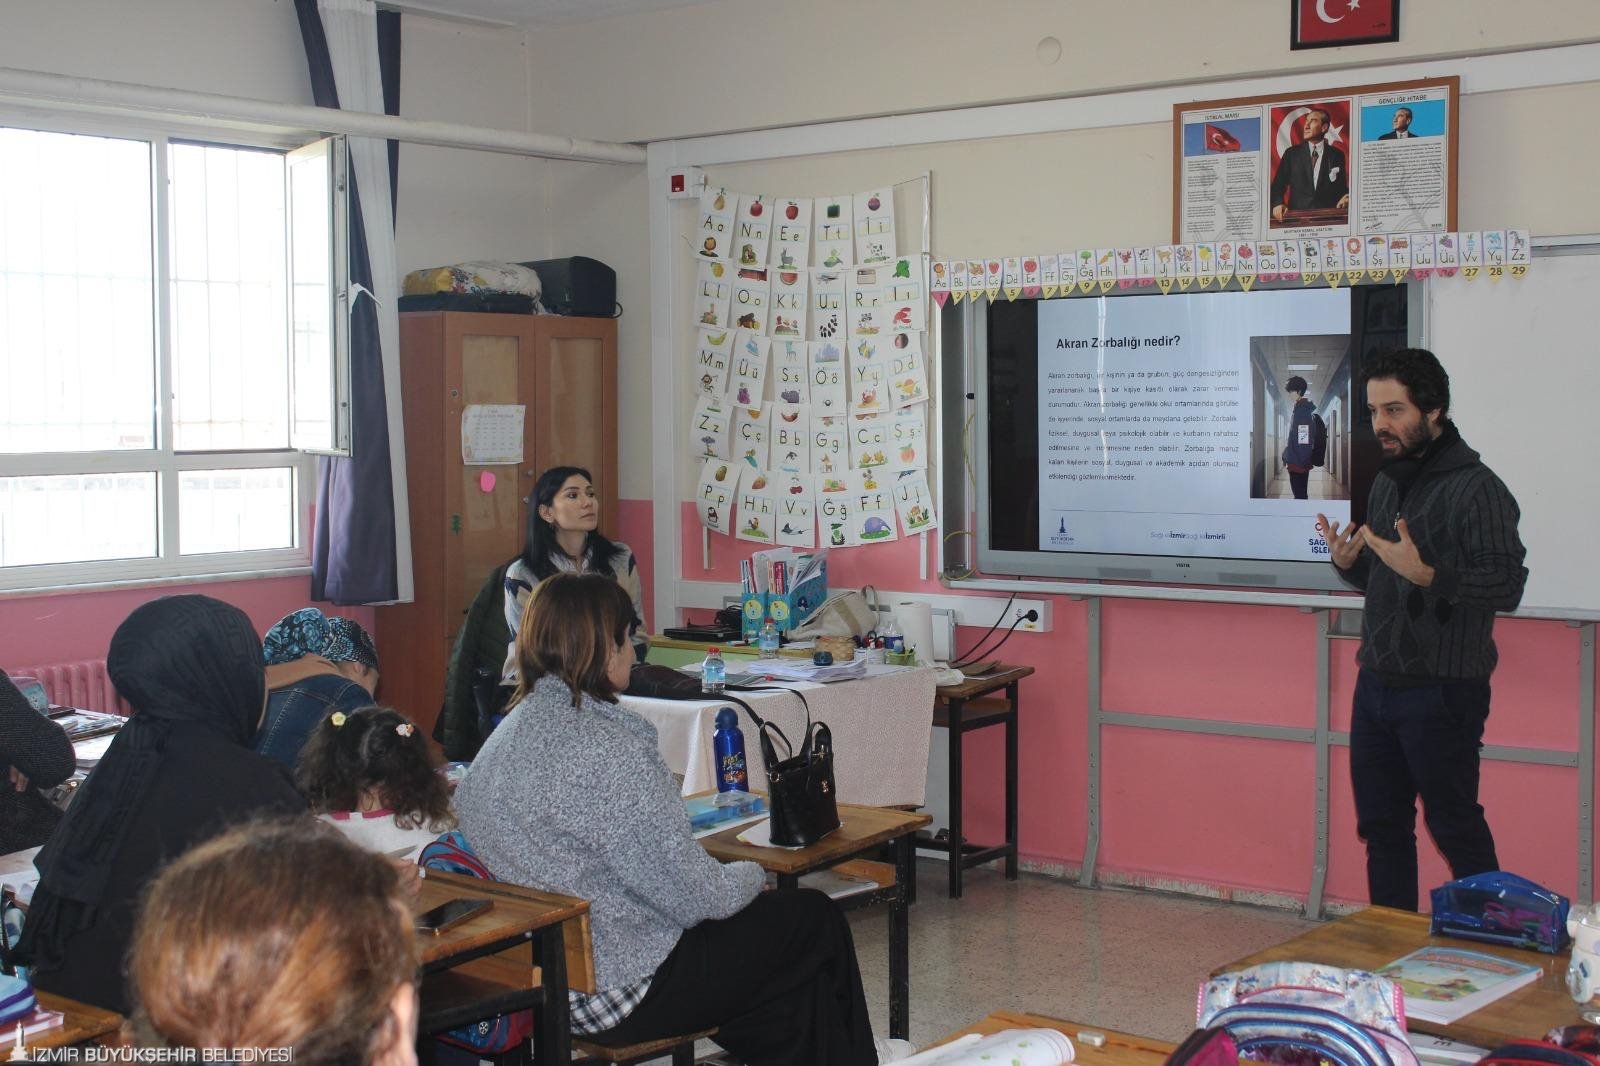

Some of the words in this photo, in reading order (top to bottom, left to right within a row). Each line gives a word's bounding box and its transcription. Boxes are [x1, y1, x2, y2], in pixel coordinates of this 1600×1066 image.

[1511, 248, 1525, 260] Zz
[1102, 281, 1111, 289] 10
[1202, 277, 1209, 285] 15
[1241, 276, 1251, 284] 17
[1329, 273, 1339, 281] 21
[1464, 268, 1478, 276] 27
[1490, 267, 1502, 276] 28
[1511, 266, 1525, 275] 29
[1056, 338, 1088, 349] Akran
[1144, 335, 1181, 347] nedir?
[1311, 546, 1330, 554] İŞLE
